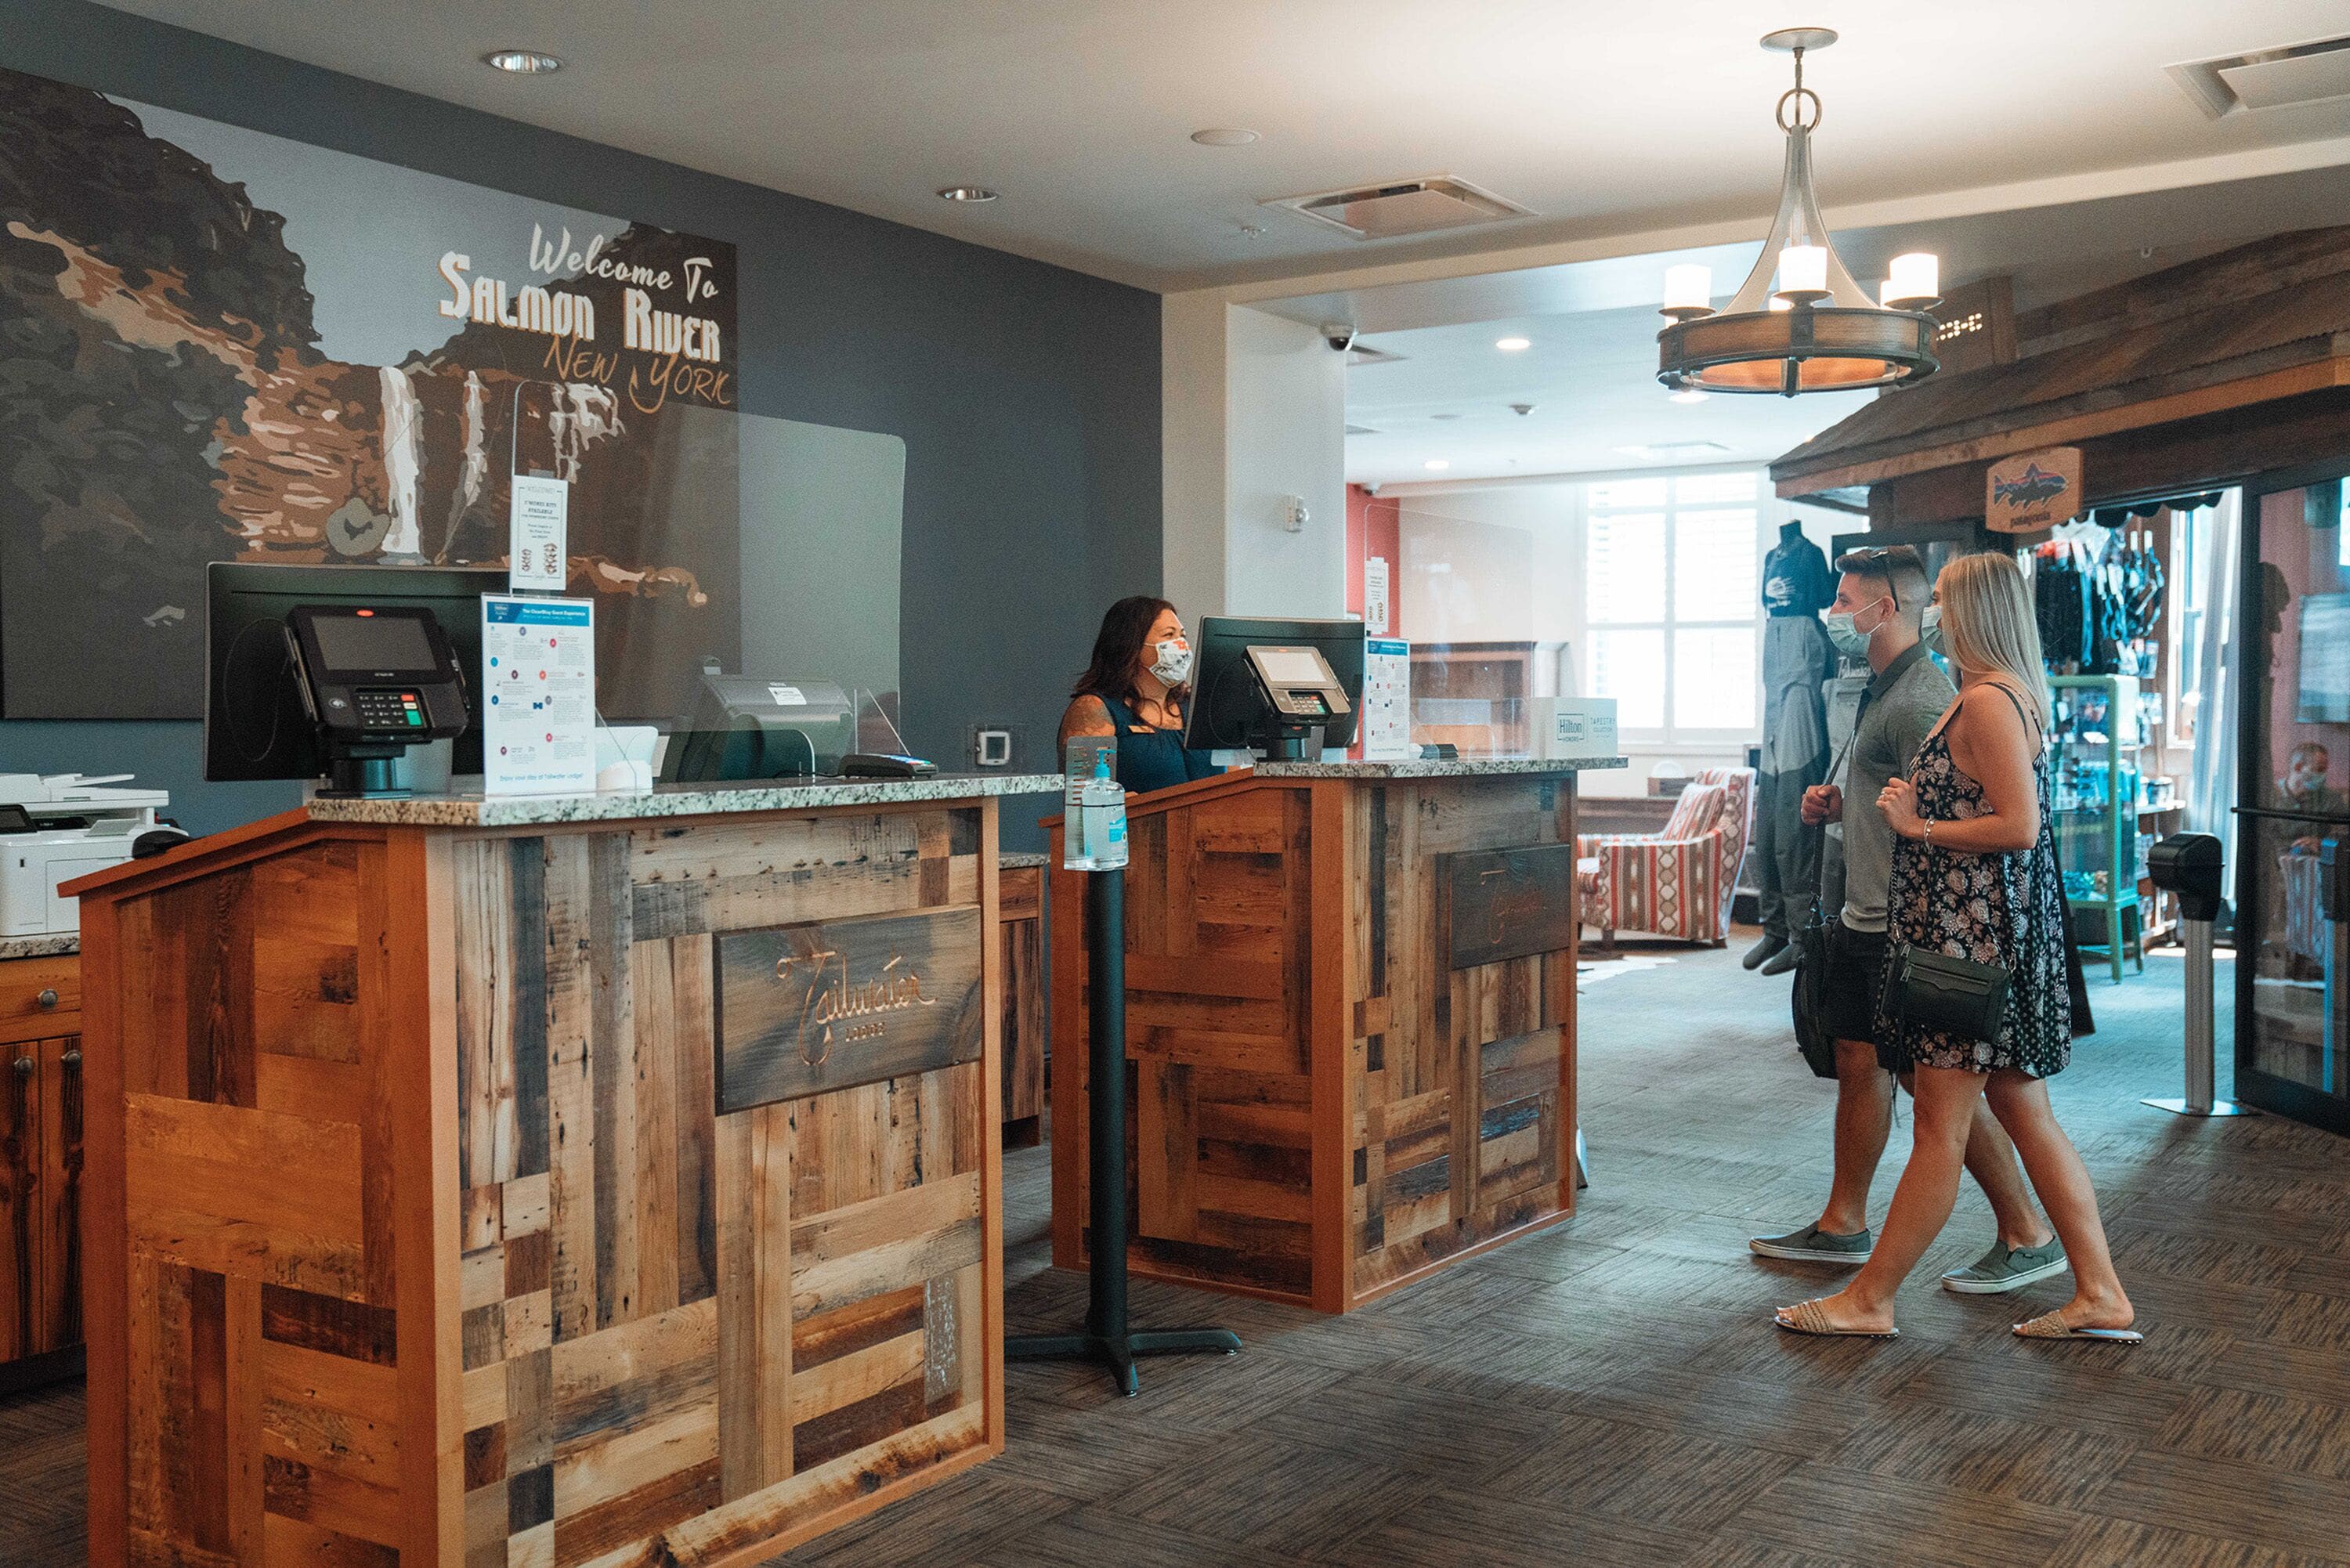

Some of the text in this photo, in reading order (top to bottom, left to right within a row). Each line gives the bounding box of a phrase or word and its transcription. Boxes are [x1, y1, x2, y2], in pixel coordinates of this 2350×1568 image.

[530, 222, 719, 304] Welcome To
[438, 251, 721, 363] SALMON RIVER
[544, 334, 732, 414] NEW YORK
[1559, 719, 1582, 734] Hilton
[776, 946, 938, 1067] Tailwater
[844, 1021, 887, 1043] LODGE
